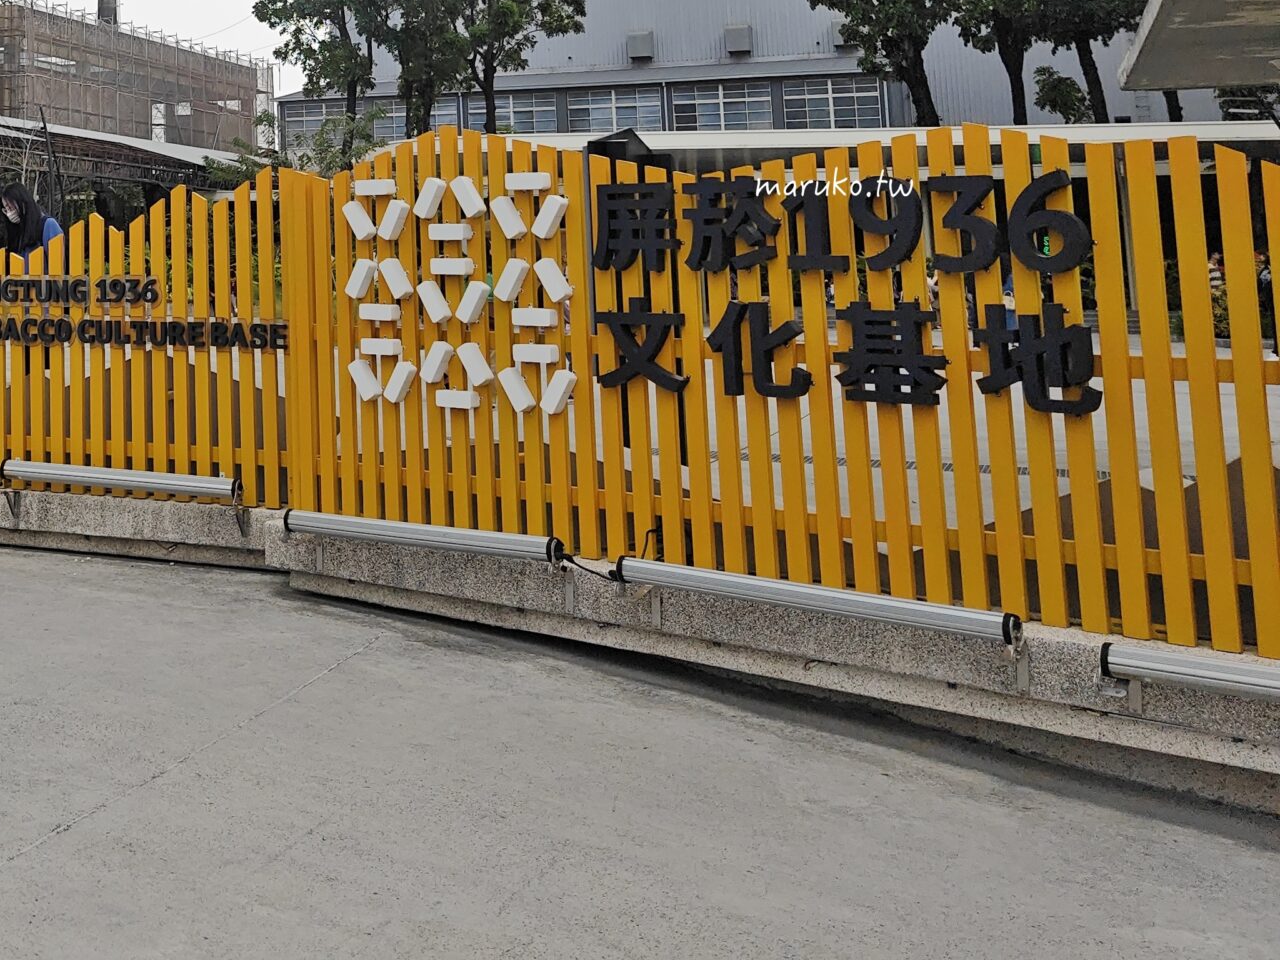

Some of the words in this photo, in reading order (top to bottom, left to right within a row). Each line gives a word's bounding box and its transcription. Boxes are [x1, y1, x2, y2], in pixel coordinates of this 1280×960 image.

[592, 168, 1094, 274] 屏菸1936
[95, 278, 159, 304] 1936
[77, 318, 205, 347] CULTURE
[210, 321, 288, 350] BASE
[594, 296, 1104, 415] 文化基地
